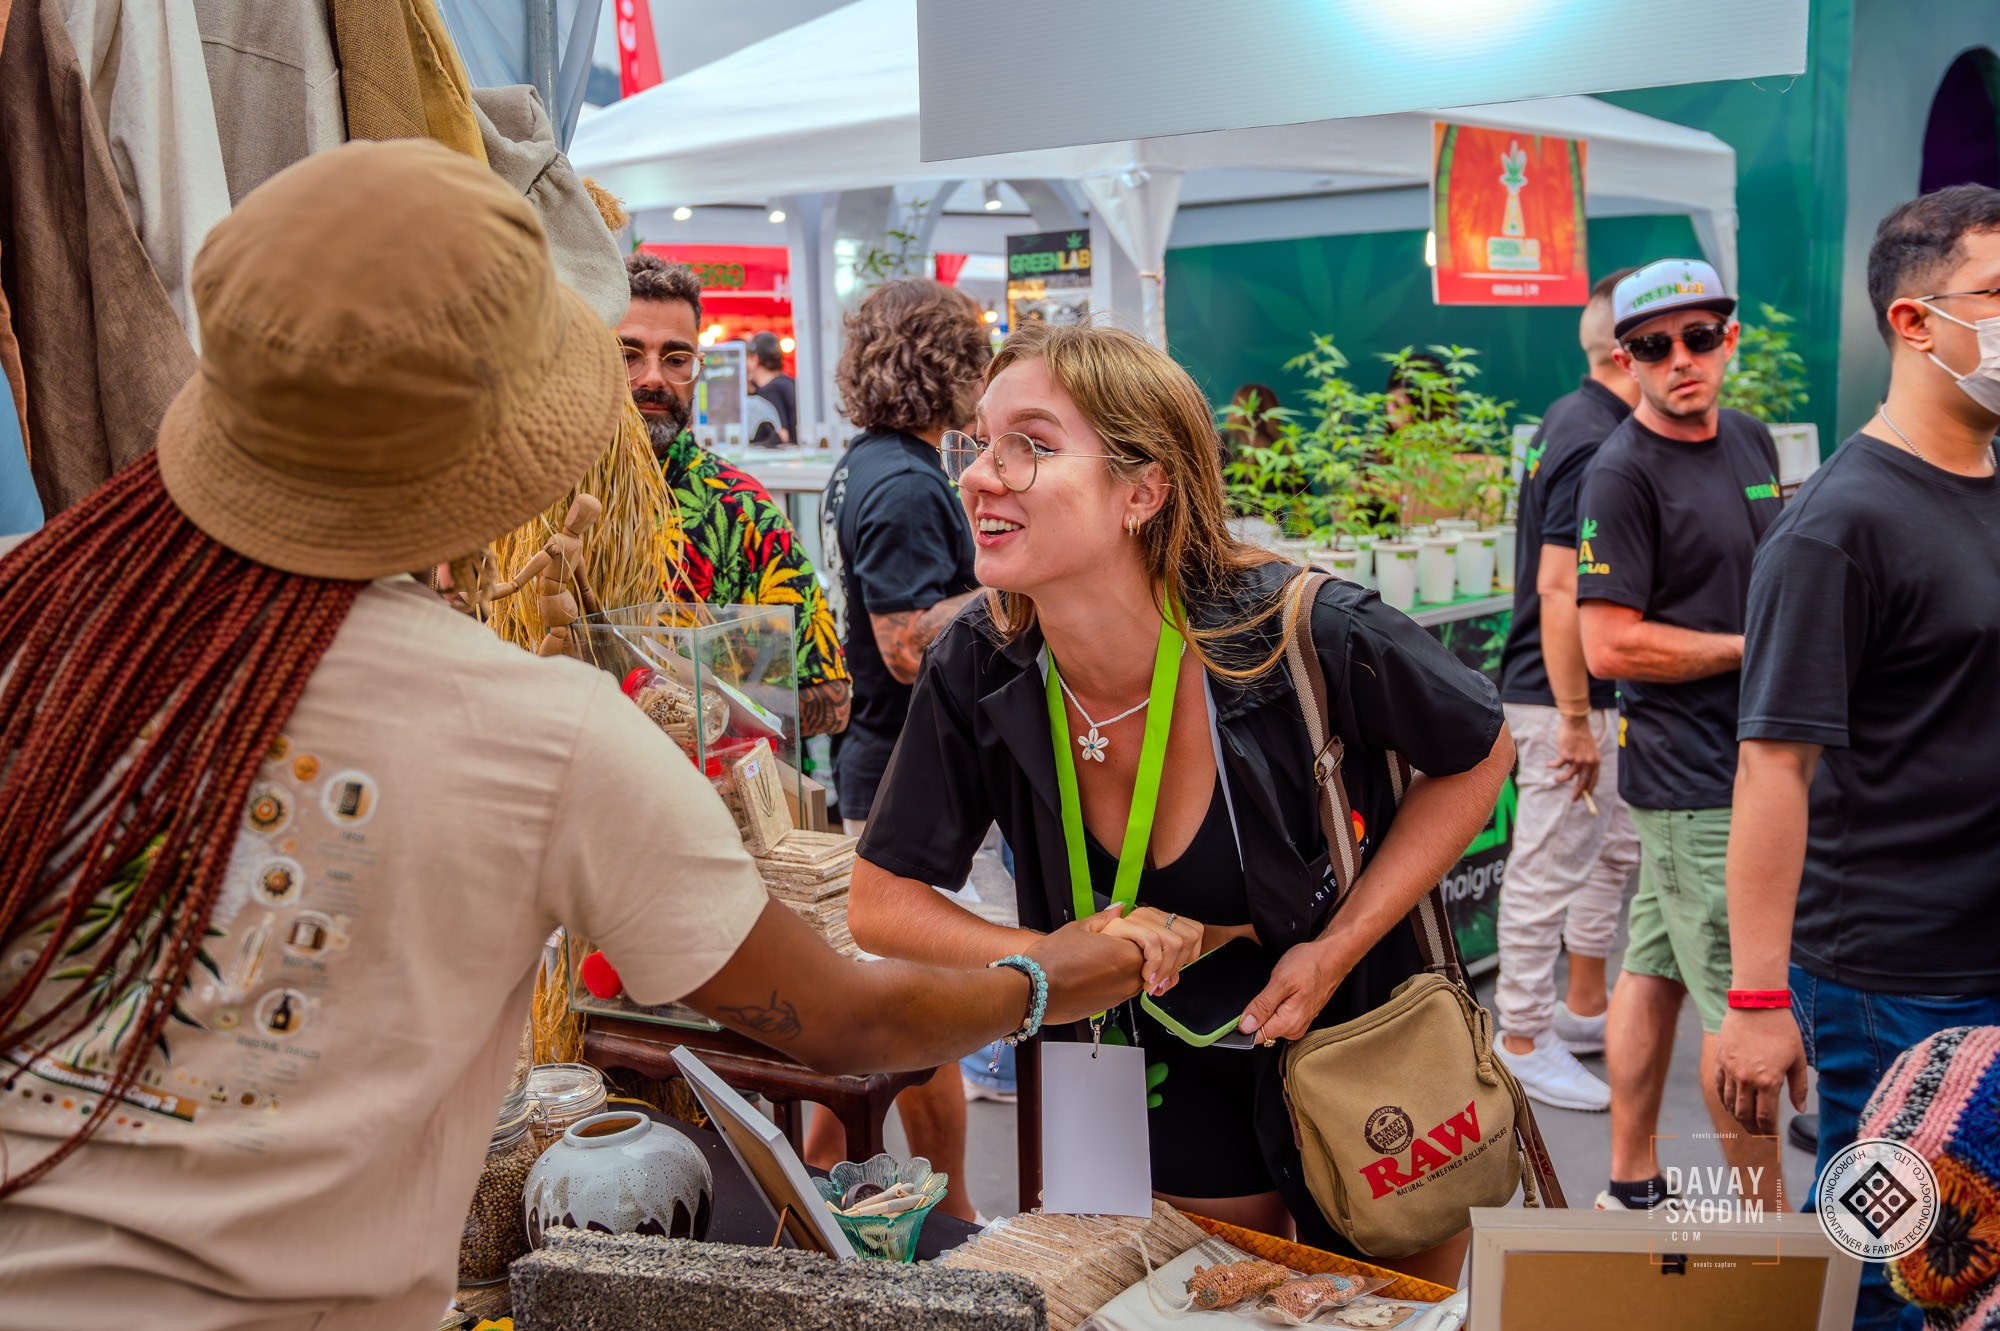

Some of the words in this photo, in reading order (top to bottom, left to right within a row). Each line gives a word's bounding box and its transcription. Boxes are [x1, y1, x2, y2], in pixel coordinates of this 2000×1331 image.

[1009, 249, 1091, 274] GREENLAB
[1631, 282, 1704, 309] GREENLAB
[1373, 1116, 1404, 1142] PUREST
[1377, 1123, 1407, 1145] NATURAL
[1382, 1128, 1408, 1149] FIBERS
[1359, 1100, 1481, 1200] RAW
[1396, 1180, 1425, 1197] NATURAL
[1426, 1160, 1463, 1183] UNREFINED
[1463, 1144, 1488, 1163] ROLLING
[1488, 1126, 1508, 1147] PAPERS
